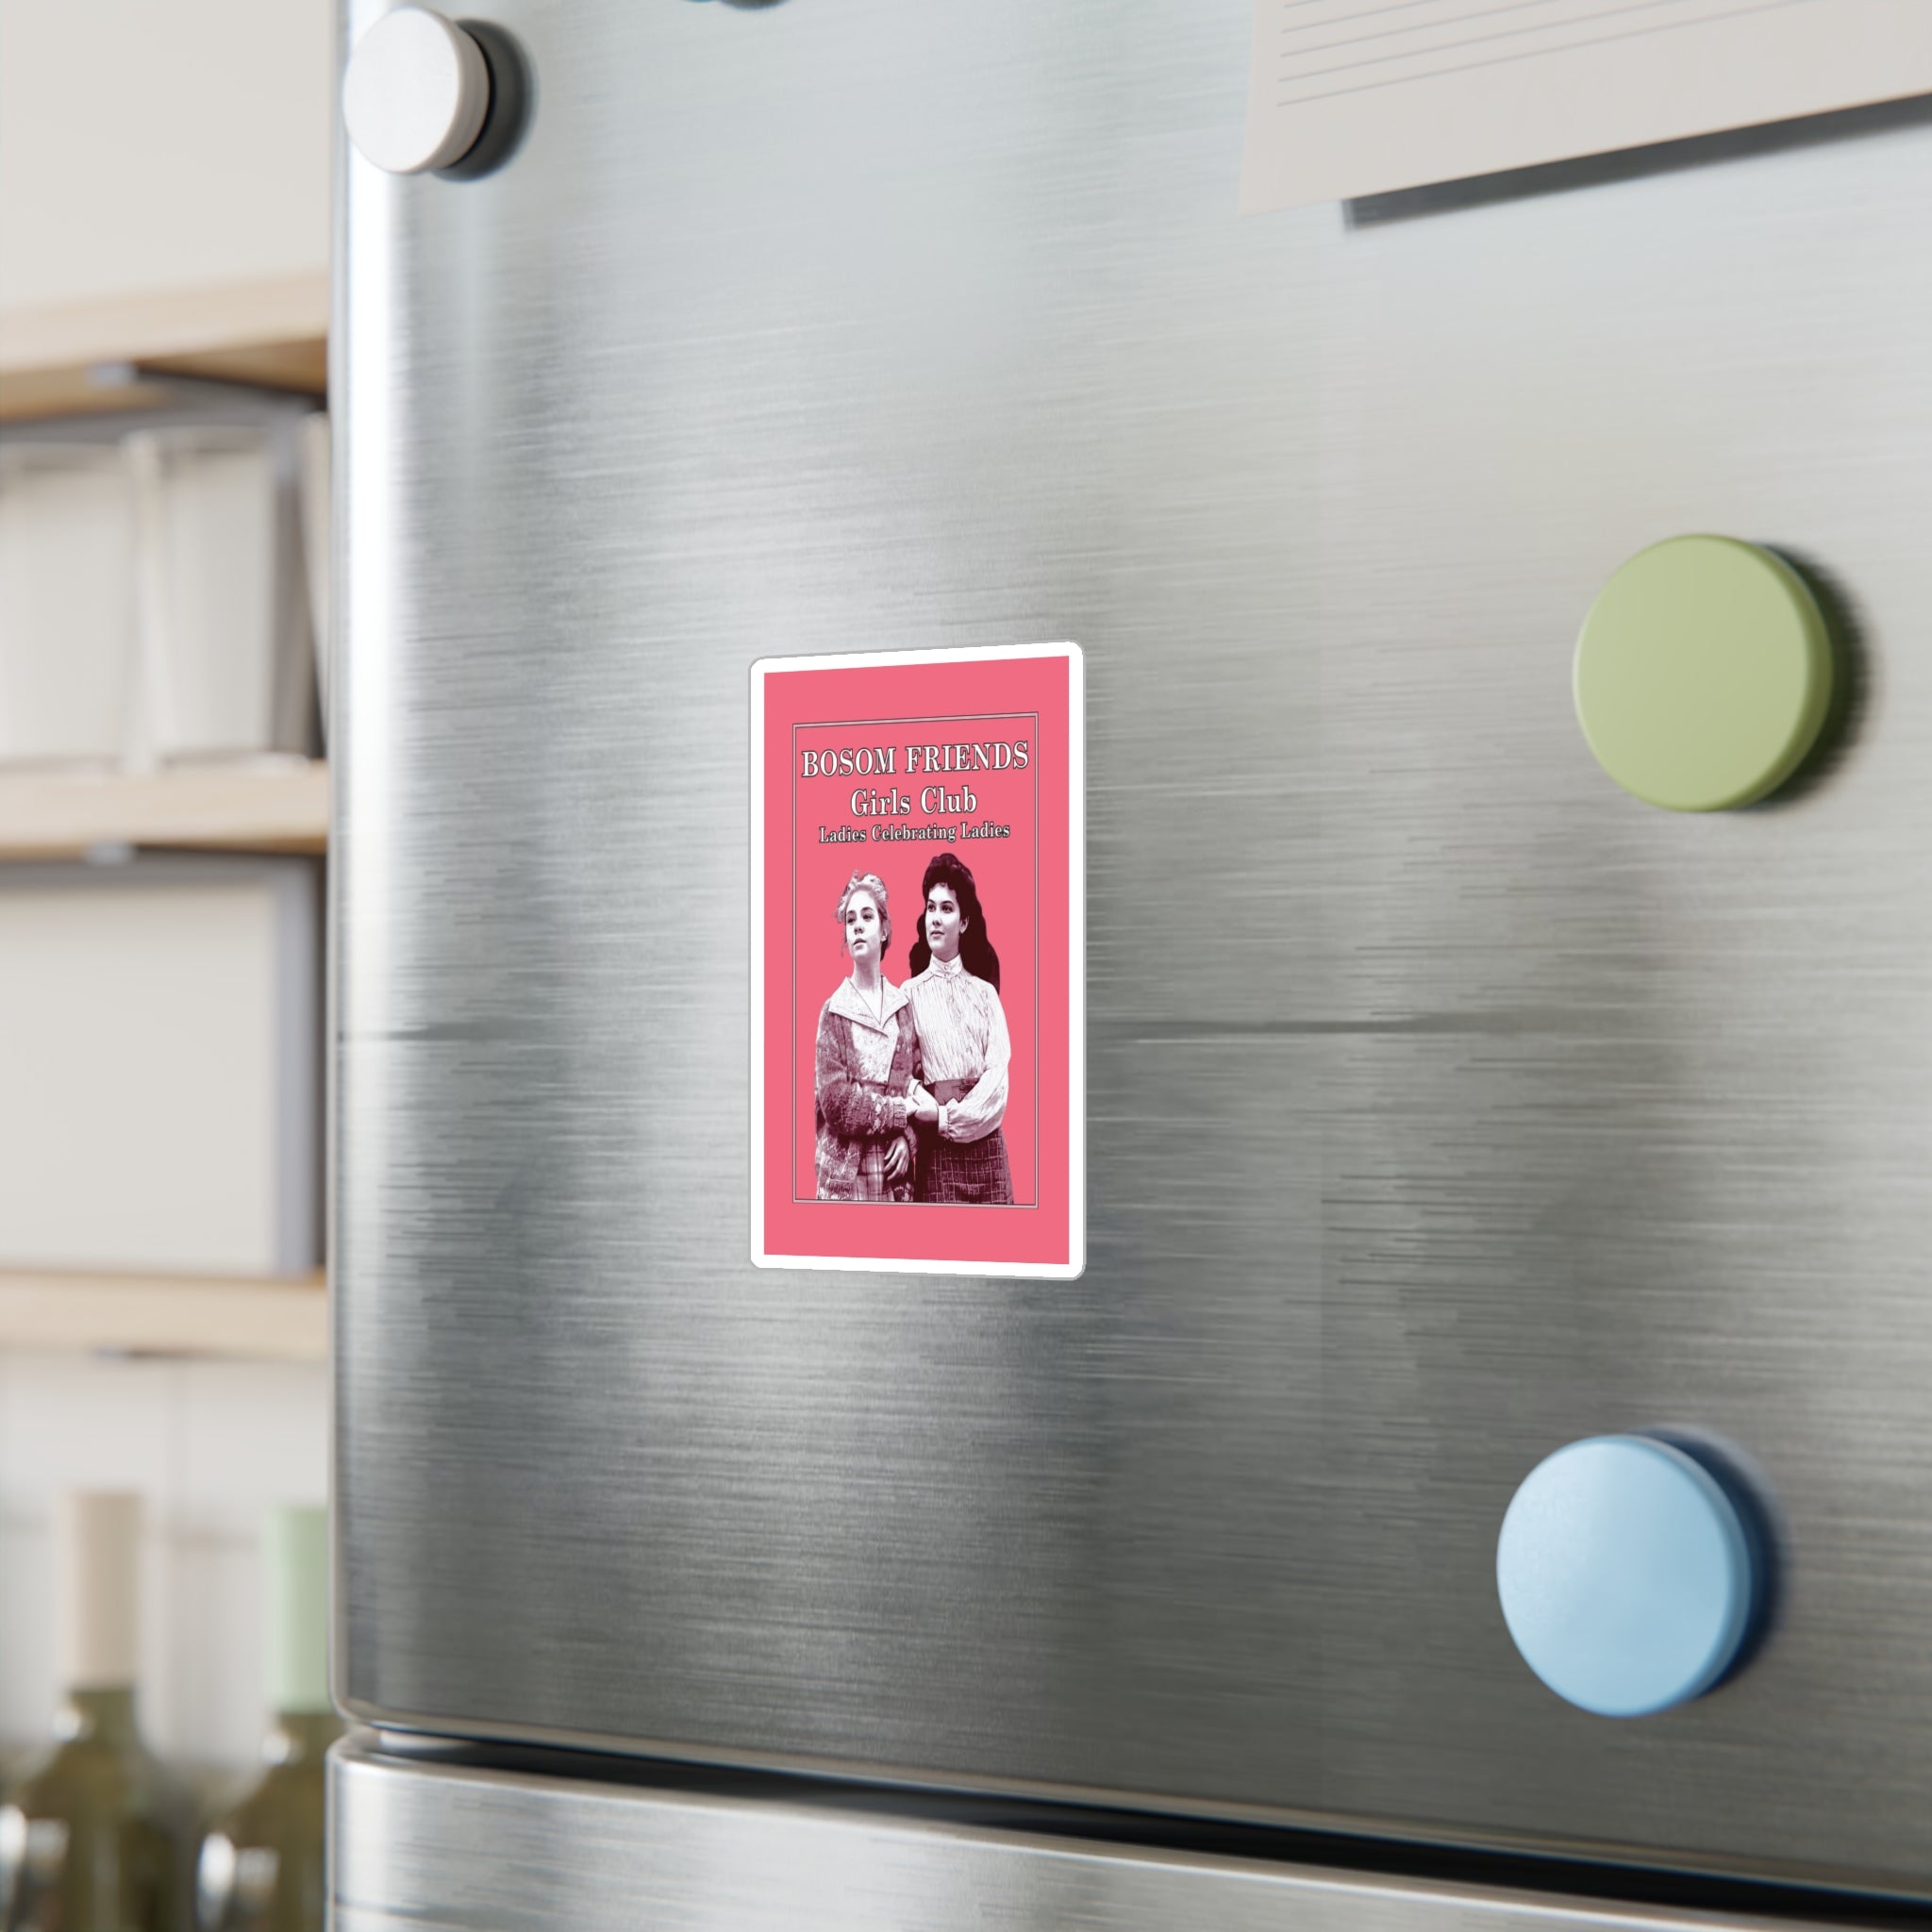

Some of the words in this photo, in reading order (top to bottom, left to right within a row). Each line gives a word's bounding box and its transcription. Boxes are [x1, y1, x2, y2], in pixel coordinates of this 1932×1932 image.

[802, 746, 897, 778] BOSOM
[905, 741, 1029, 774] FRIENDS
[850, 788, 911, 817] Girls
[921, 785, 978, 814] Club
[819, 825, 867, 843] Ladies
[872, 824, 957, 842] Celebrating
[960, 821, 1010, 840] Ladies
